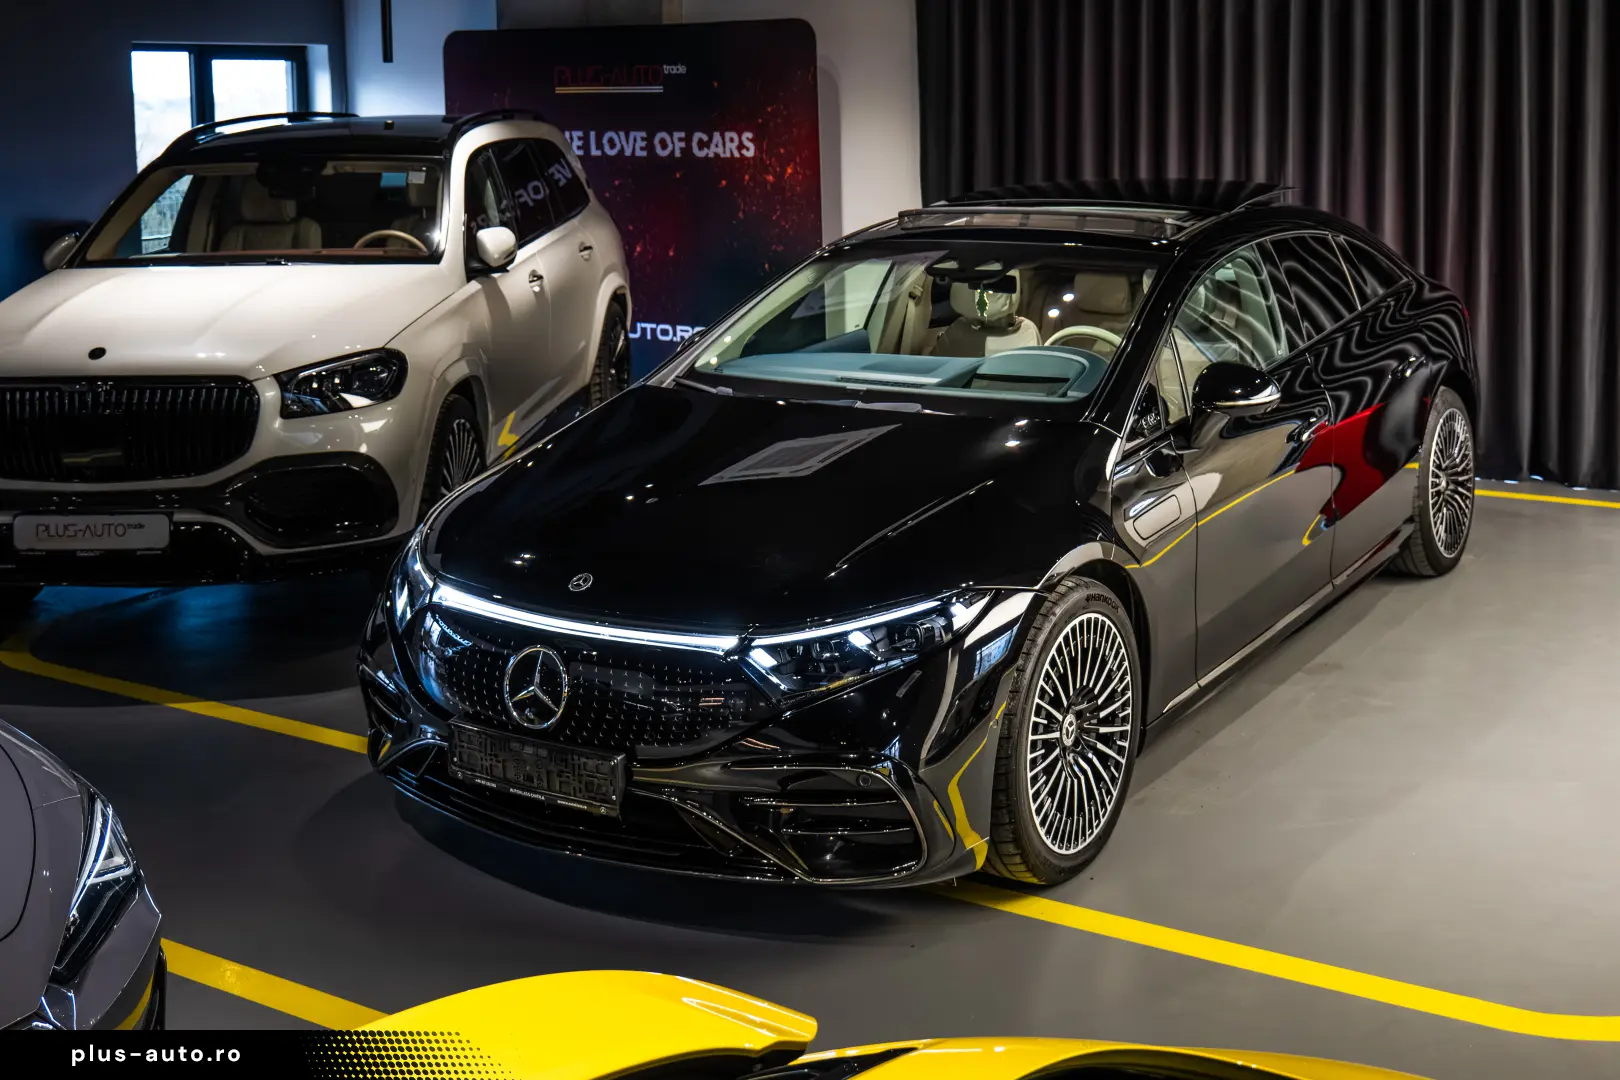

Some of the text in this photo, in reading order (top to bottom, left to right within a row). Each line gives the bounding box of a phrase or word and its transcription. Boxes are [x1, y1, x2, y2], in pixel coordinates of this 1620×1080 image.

[663, 63, 687, 74] trade
[589, 130, 648, 157] LOVE
[653, 130, 687, 158] OF
[692, 131, 756, 158] CARS
[35, 522, 127, 538] PLUS-AUTO
